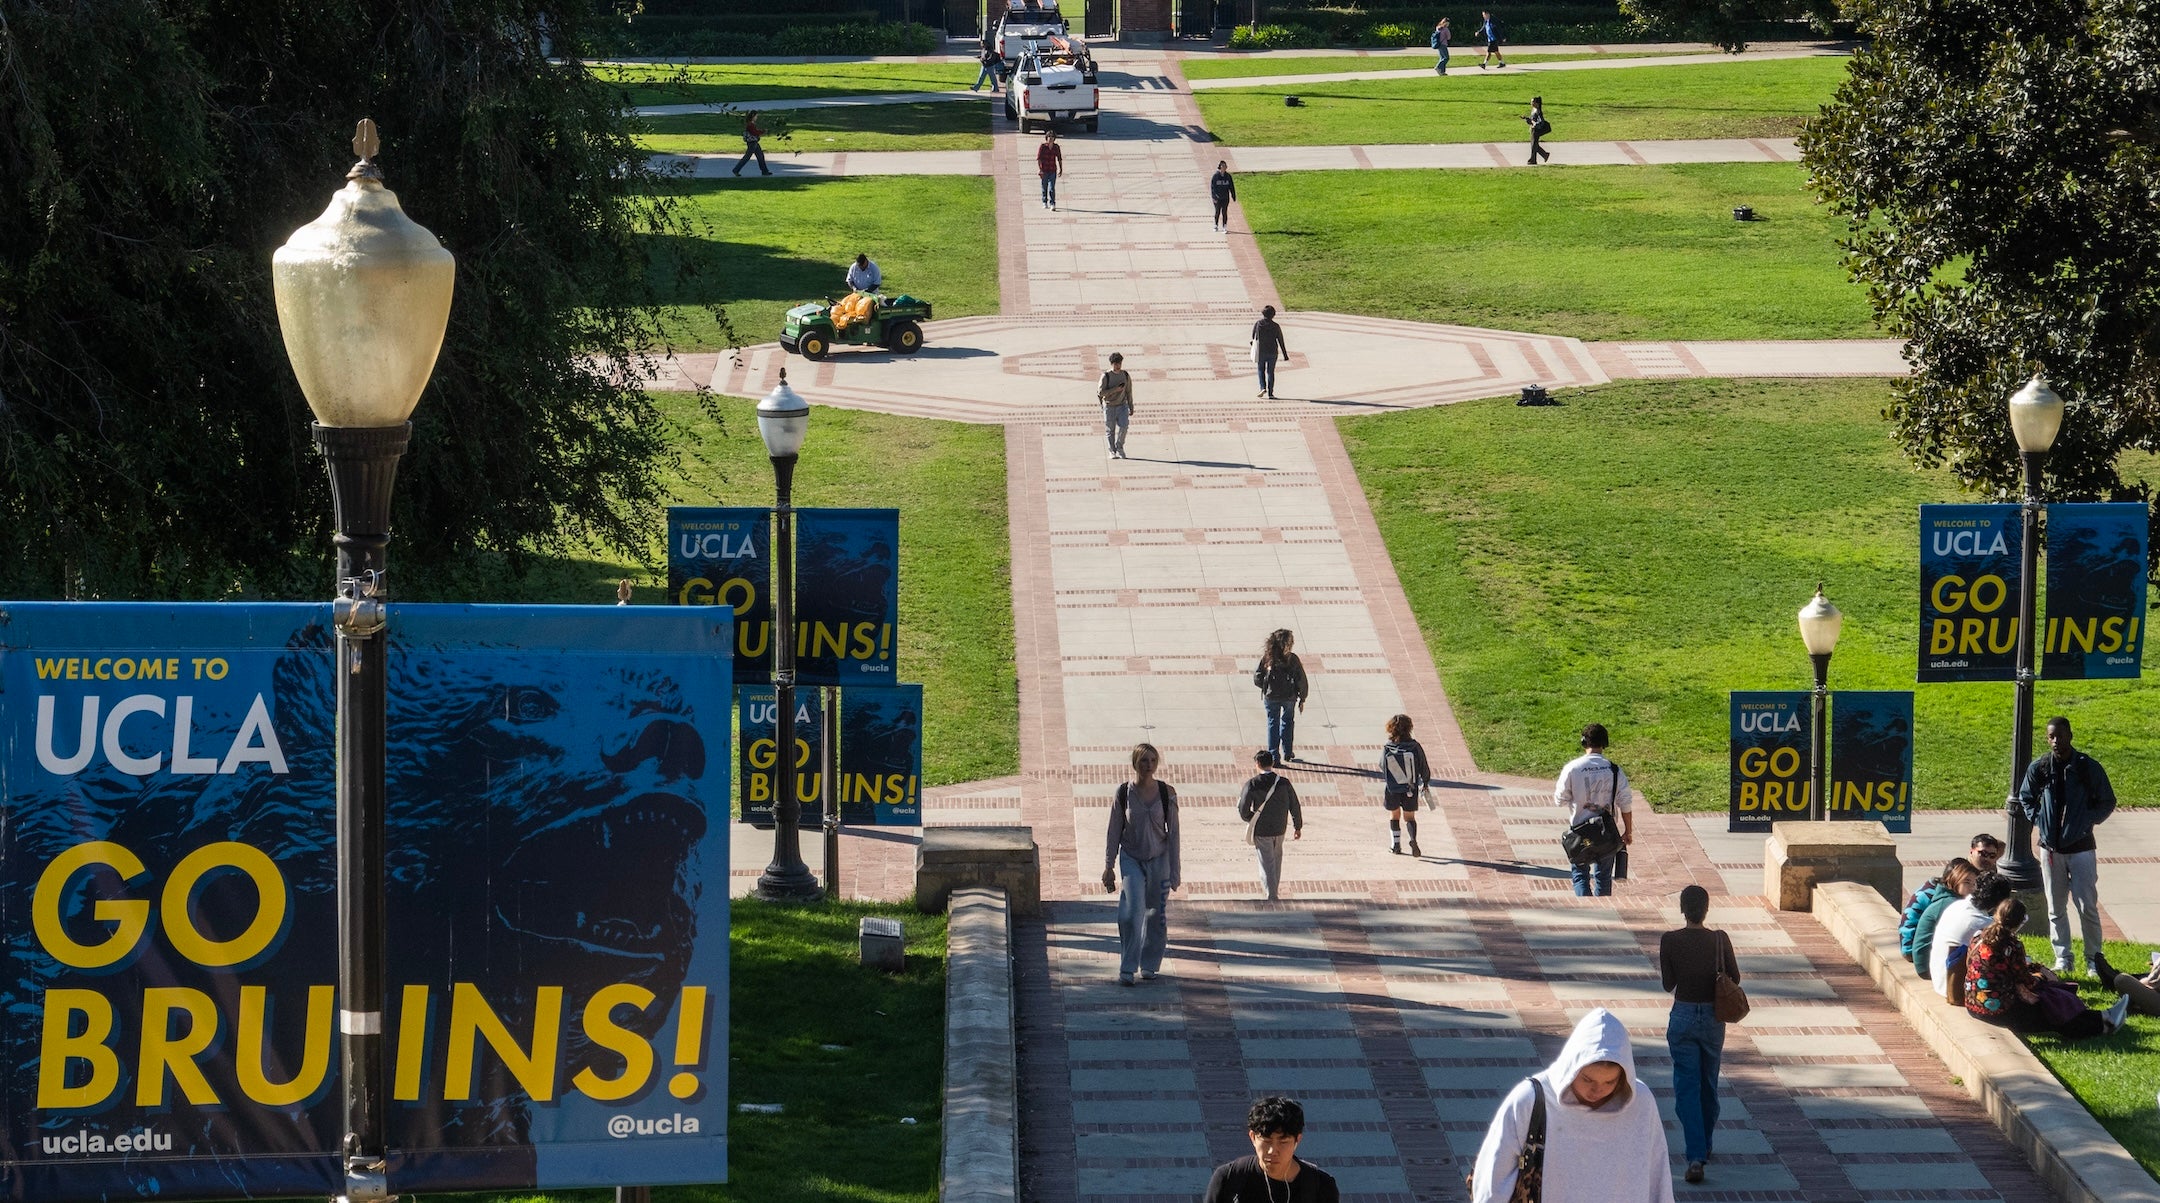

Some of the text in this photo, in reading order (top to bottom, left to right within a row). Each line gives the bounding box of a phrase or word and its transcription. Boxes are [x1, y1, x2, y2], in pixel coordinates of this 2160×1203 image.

[681, 522, 740, 531] WELCOME TO
[1933, 520, 1991, 528] WELCOME TO
[680, 534, 757, 559] UCLA
[1932, 530, 2009, 556] UCLA
[678, 577, 756, 616] GO
[1930, 574, 2007, 614] GO
[35, 657, 230, 681] WELCOME TO
[860, 664, 889, 673] @ucla
[1930, 659, 1969, 669] ucla.edu
[2106, 656, 2134, 665] @ucla
[749, 703, 812, 724] UCA
[1739, 711, 1802, 733] UCLA
[34, 691, 291, 777] UCLA
[1738, 746, 1801, 779] GO
[892, 806, 916, 815] @ucla
[1739, 814, 1772, 822] ucla.edu
[1882, 814, 1906, 822] @ucla
[32, 840, 287, 969] GO
[606, 1114, 701, 1139] @ucla
[42, 1128, 173, 1155] ucla.edu
